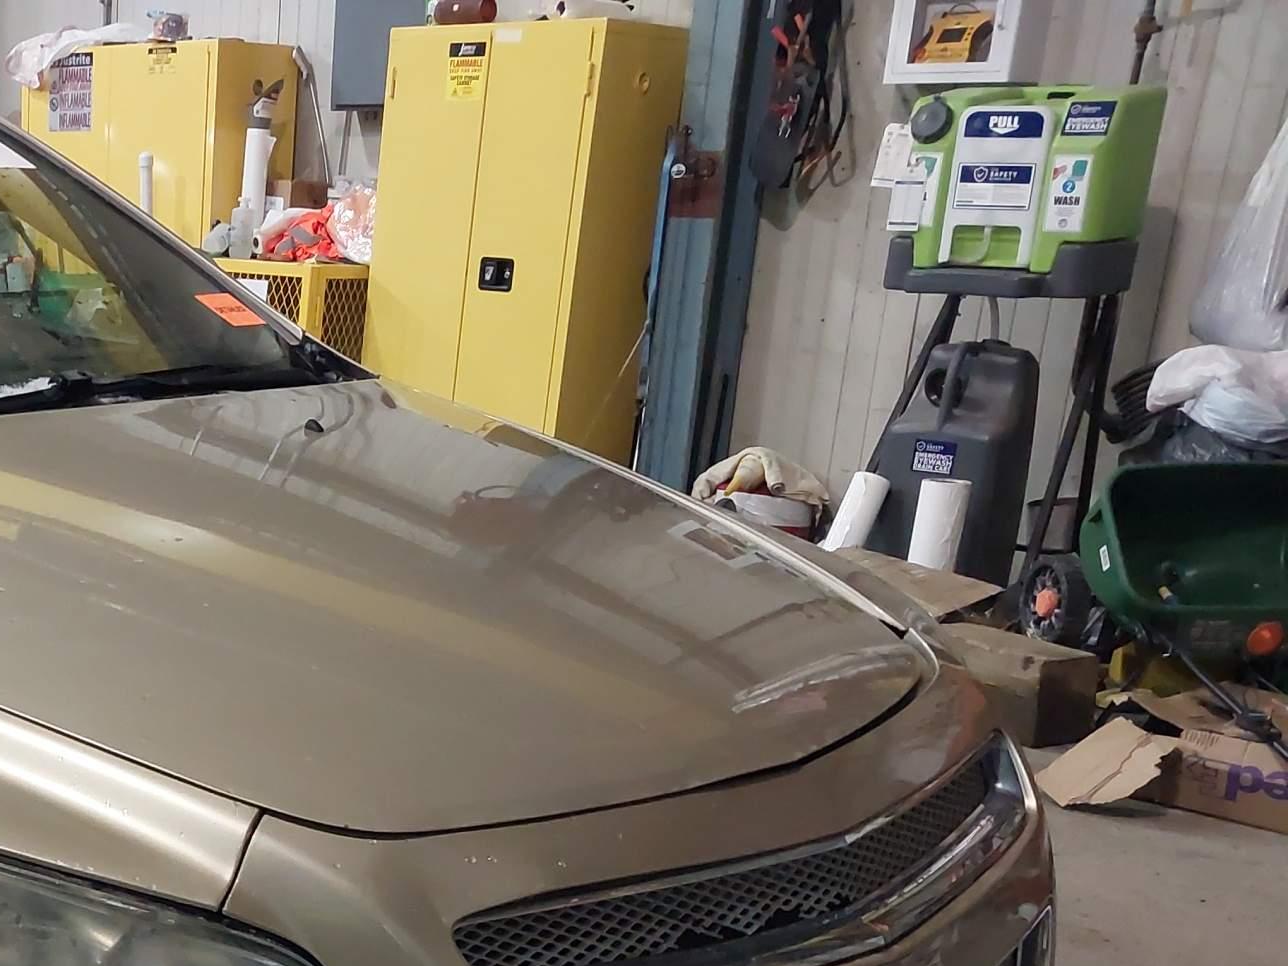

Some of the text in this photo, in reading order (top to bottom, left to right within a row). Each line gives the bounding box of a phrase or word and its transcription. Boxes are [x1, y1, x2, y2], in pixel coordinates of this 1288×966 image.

[989, 115, 1020, 129] PULL
[1065, 122, 1108, 131] EYEWASH
[989, 171, 1018, 179] SAFETY
[1065, 181, 1074, 193] 2
[1054, 196, 1080, 206] WASH
